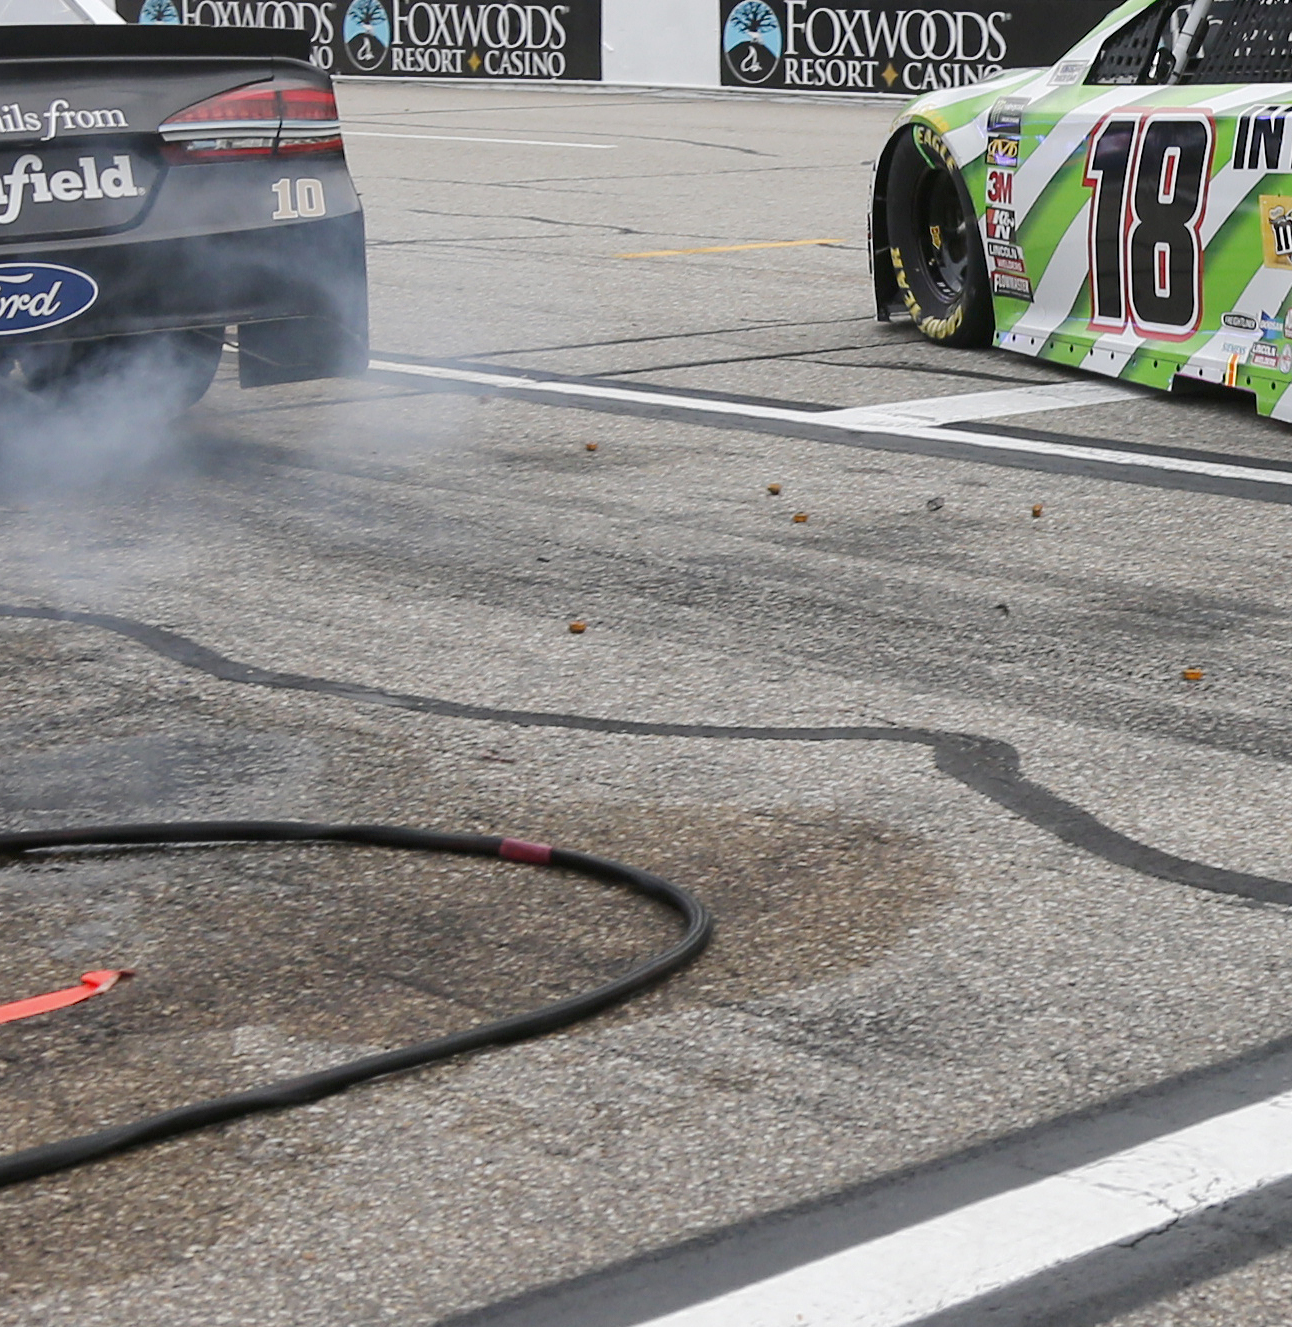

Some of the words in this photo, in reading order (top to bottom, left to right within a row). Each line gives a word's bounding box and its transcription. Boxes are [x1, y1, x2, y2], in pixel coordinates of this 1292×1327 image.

[783, 0, 1008, 62] FOXWOODS
[392, 47, 464, 74] RESORT
[482, 48, 566, 78] CASINO
[784, 58, 879, 88] RESORT
[902, 62, 1004, 90] CASIN
[41, 98, 128, 143] from
[916, 125, 957, 175] EAGLE
[271, 176, 327, 222] 10
[988, 170, 1013, 204] 3M
[1084, 108, 1214, 340] 18
[988, 243, 1018, 260] LINCOLN
